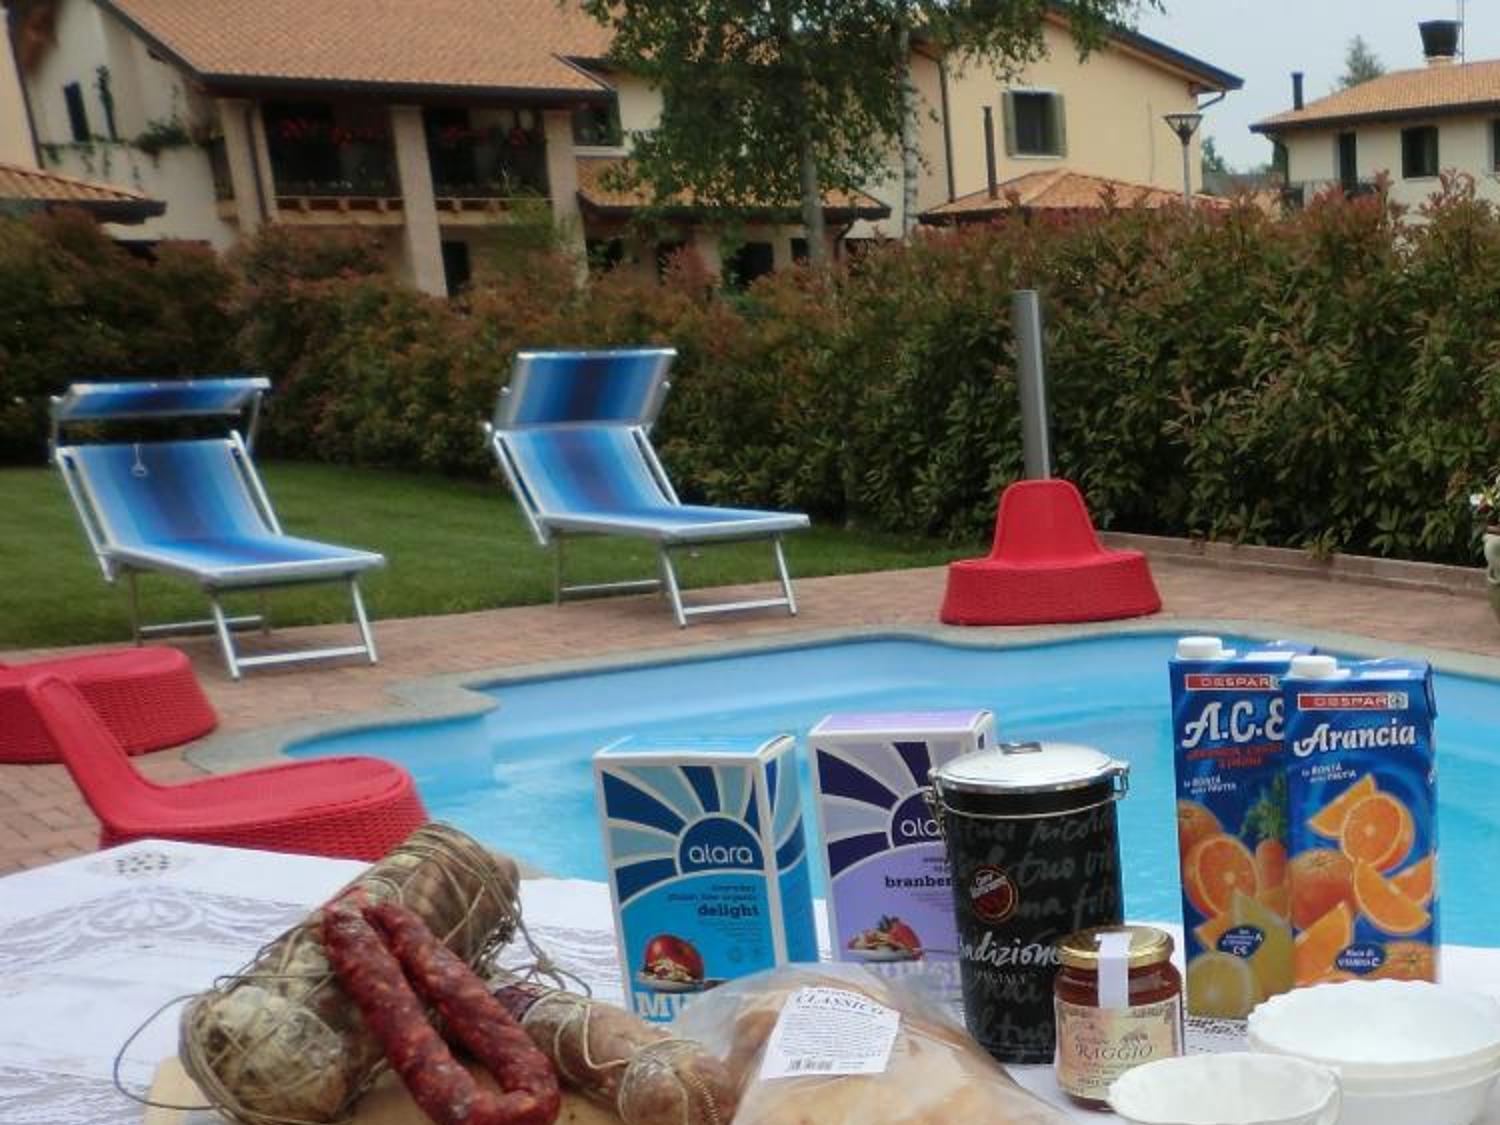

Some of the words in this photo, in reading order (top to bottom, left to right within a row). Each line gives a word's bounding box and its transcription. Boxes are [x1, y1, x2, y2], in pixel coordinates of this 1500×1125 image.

[1200, 677, 1269, 688] DESPAR
[1312, 696, 1387, 707] DESPAR
[1293, 717, 1416, 757] Arancia
[901, 817, 942, 838] ala
[688, 843, 753, 864] alara
[885, 875, 952, 889] branber
[697, 901, 760, 919] delight
